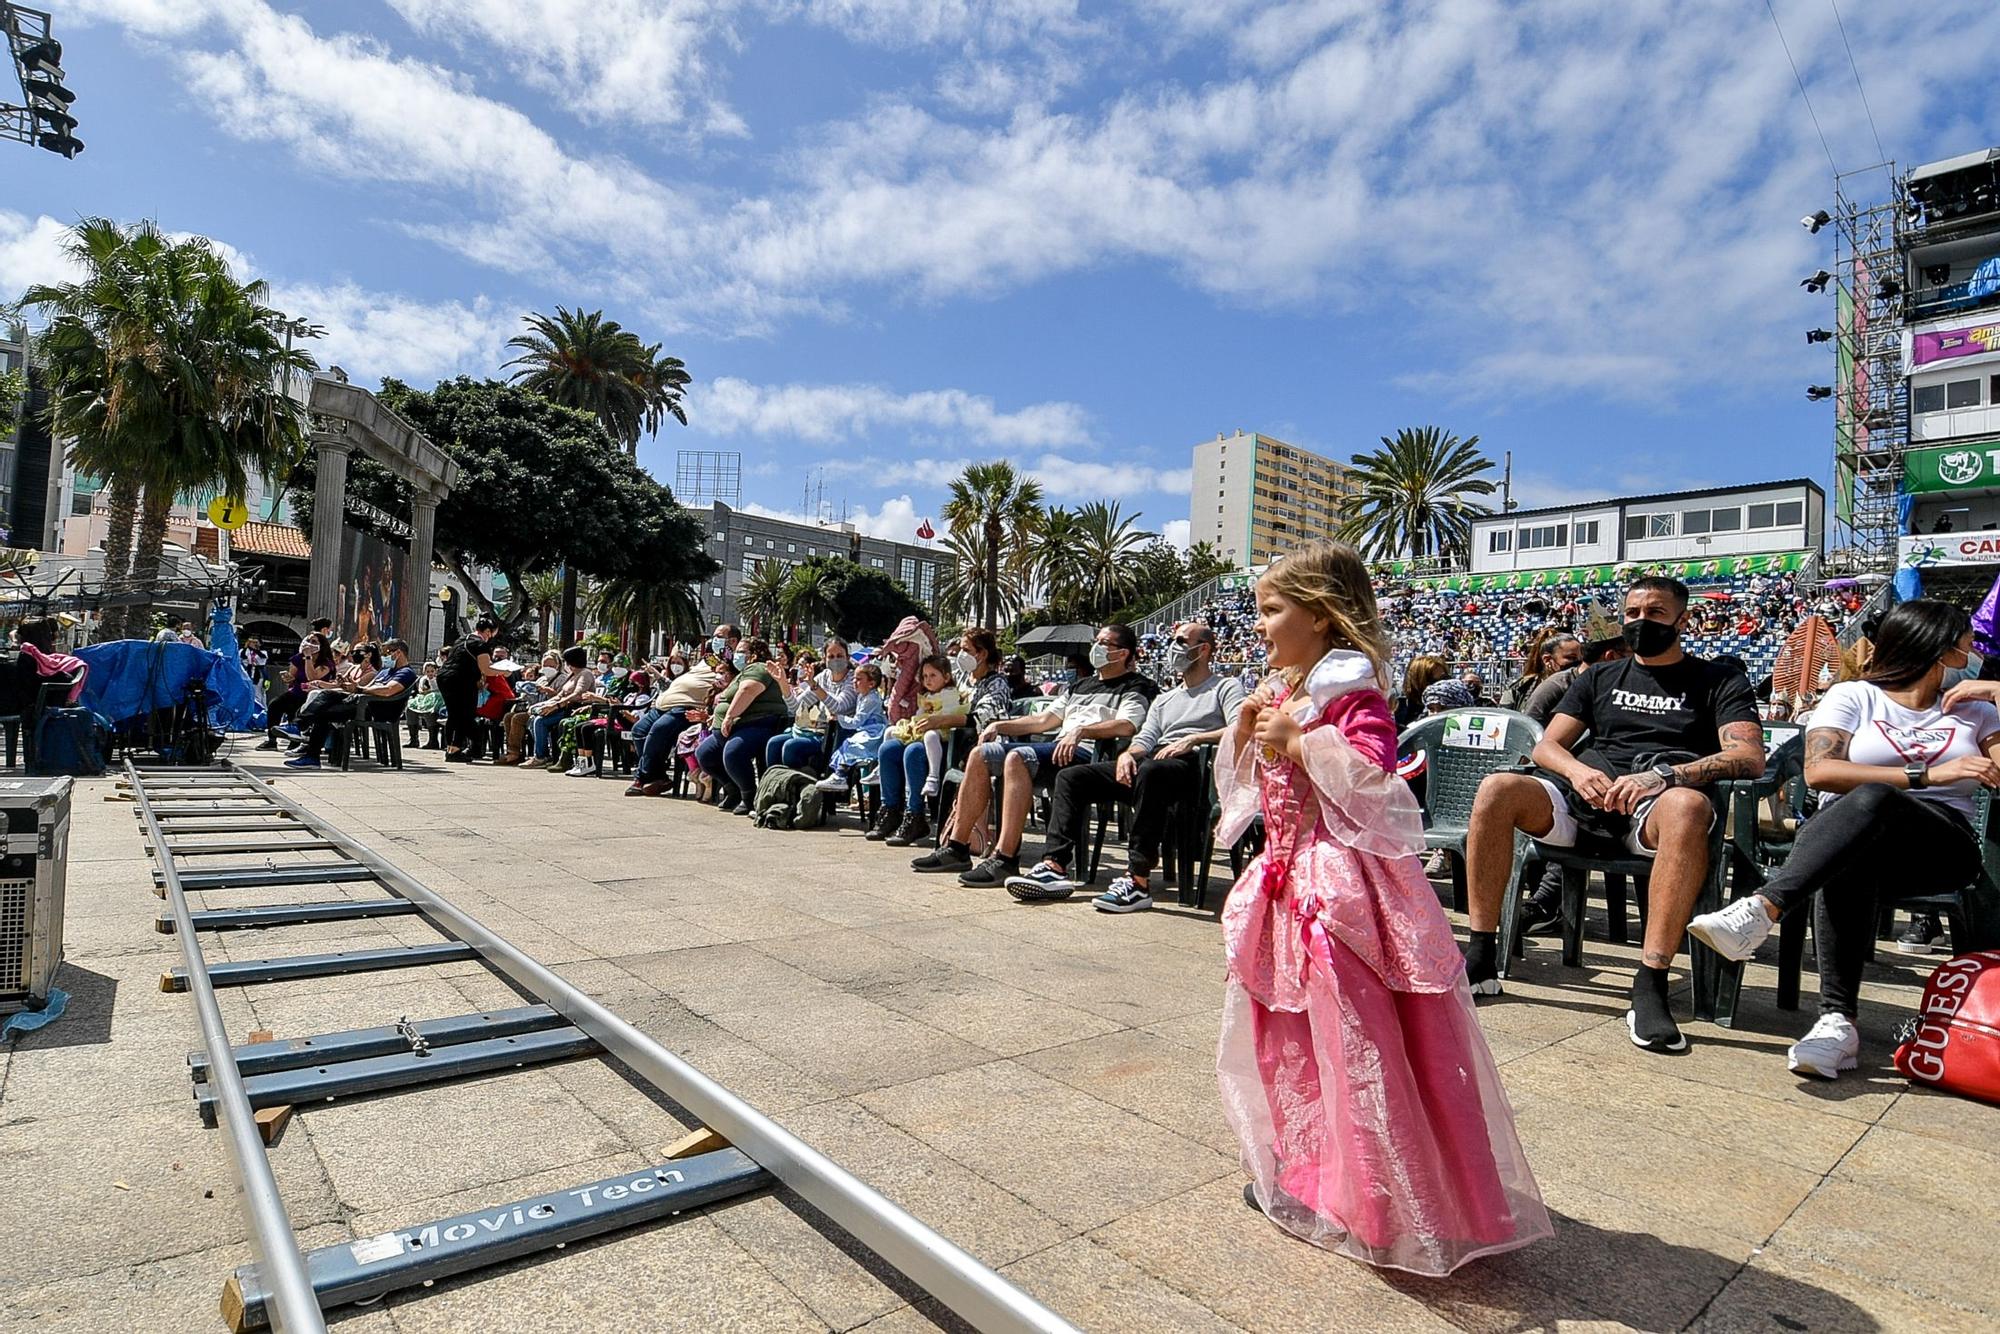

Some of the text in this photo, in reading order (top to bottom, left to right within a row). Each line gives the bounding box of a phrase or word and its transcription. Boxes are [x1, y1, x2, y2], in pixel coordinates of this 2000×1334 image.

[1611, 689, 1686, 711] TOMMY
[1467, 733, 1481, 746] 11
[1886, 727, 1946, 742] GUESS
[1908, 958, 1983, 1081] GUESS
[397, 1203, 555, 1252] Movie
[569, 1168, 685, 1208] Tech
